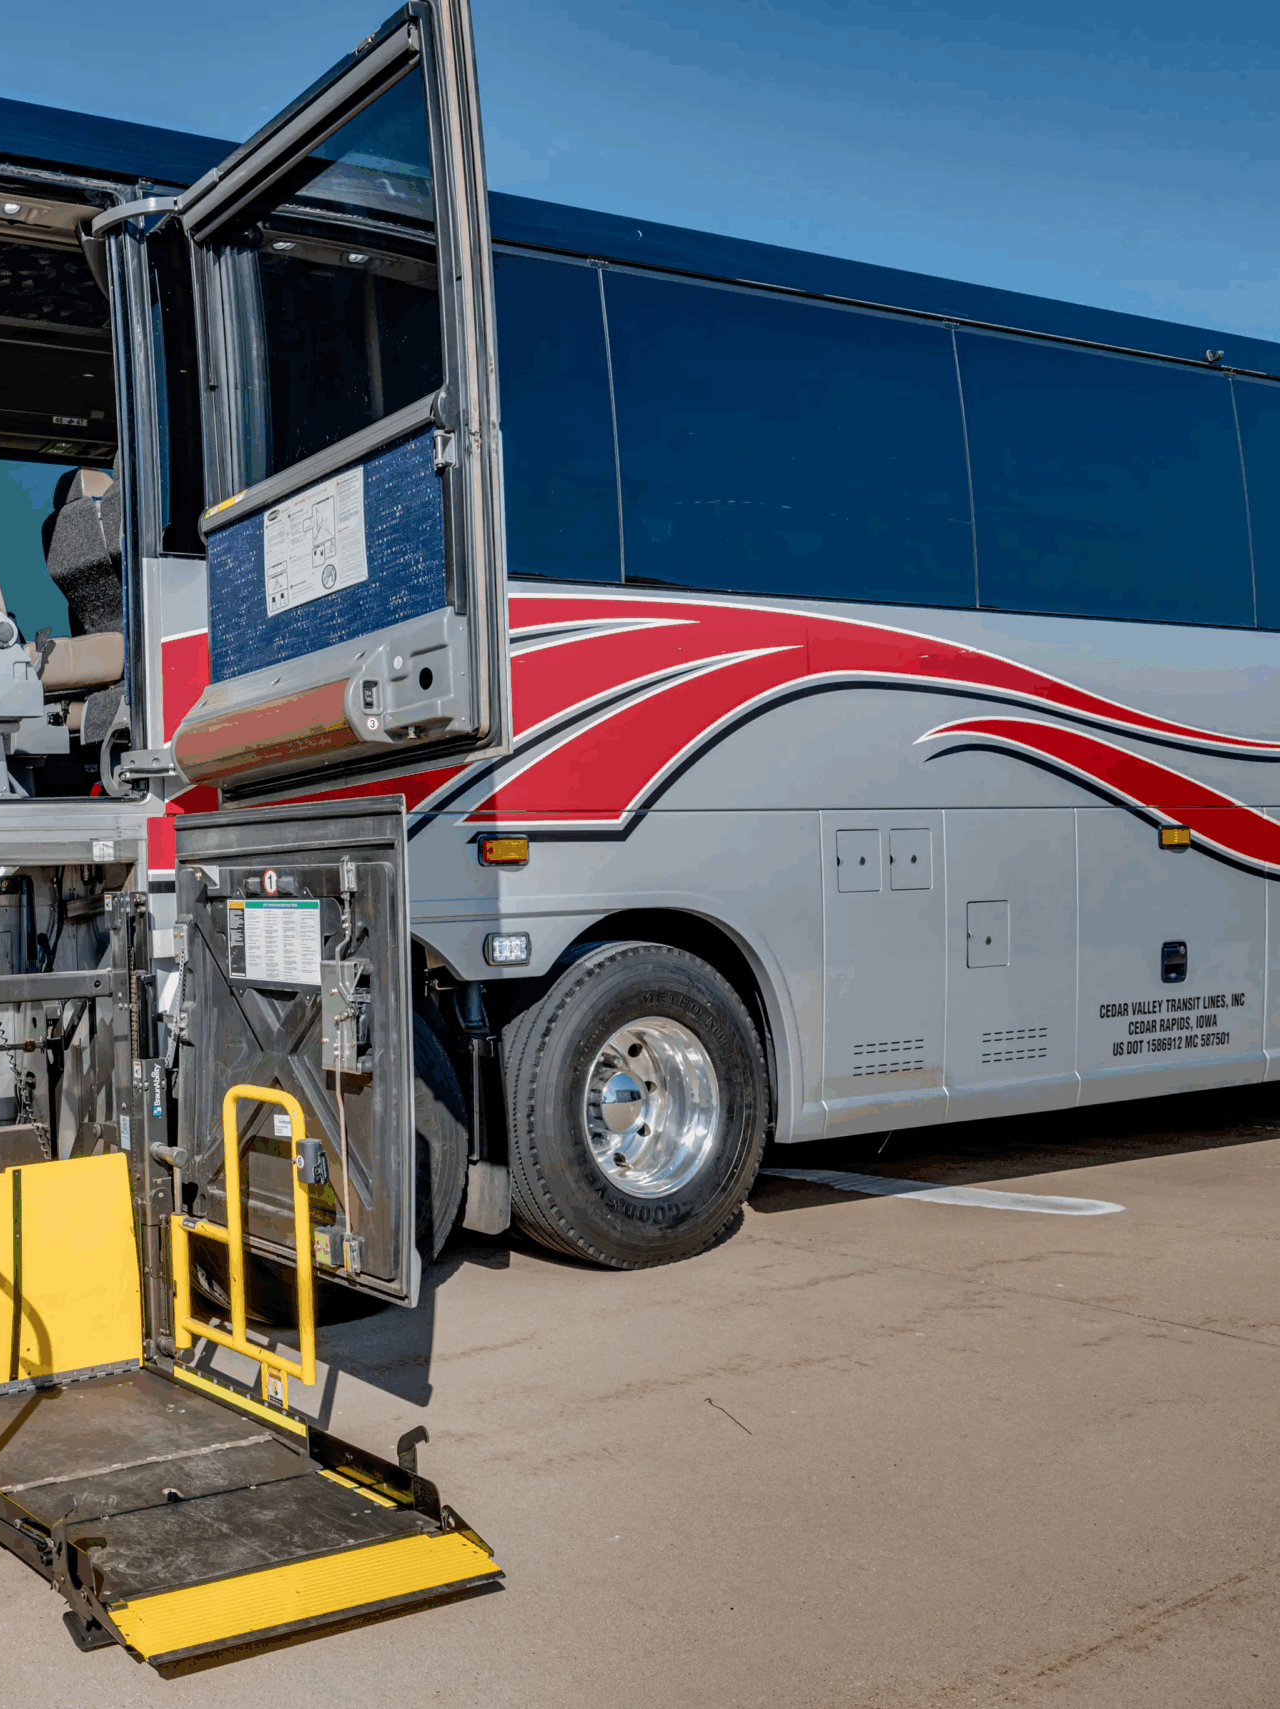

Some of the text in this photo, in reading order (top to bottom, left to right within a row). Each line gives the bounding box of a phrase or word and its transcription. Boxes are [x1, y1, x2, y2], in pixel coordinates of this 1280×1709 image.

[1099, 992, 1245, 1019] CEDAR VALLEY TRANSIT LINES, INC
[1128, 1014, 1218, 1036] CEDAR RAPIDS, IOWA
[1112, 1031, 1230, 1057] US DOT 1586912 MC 587501
[150, 1063, 162, 1106] BraunAbility
